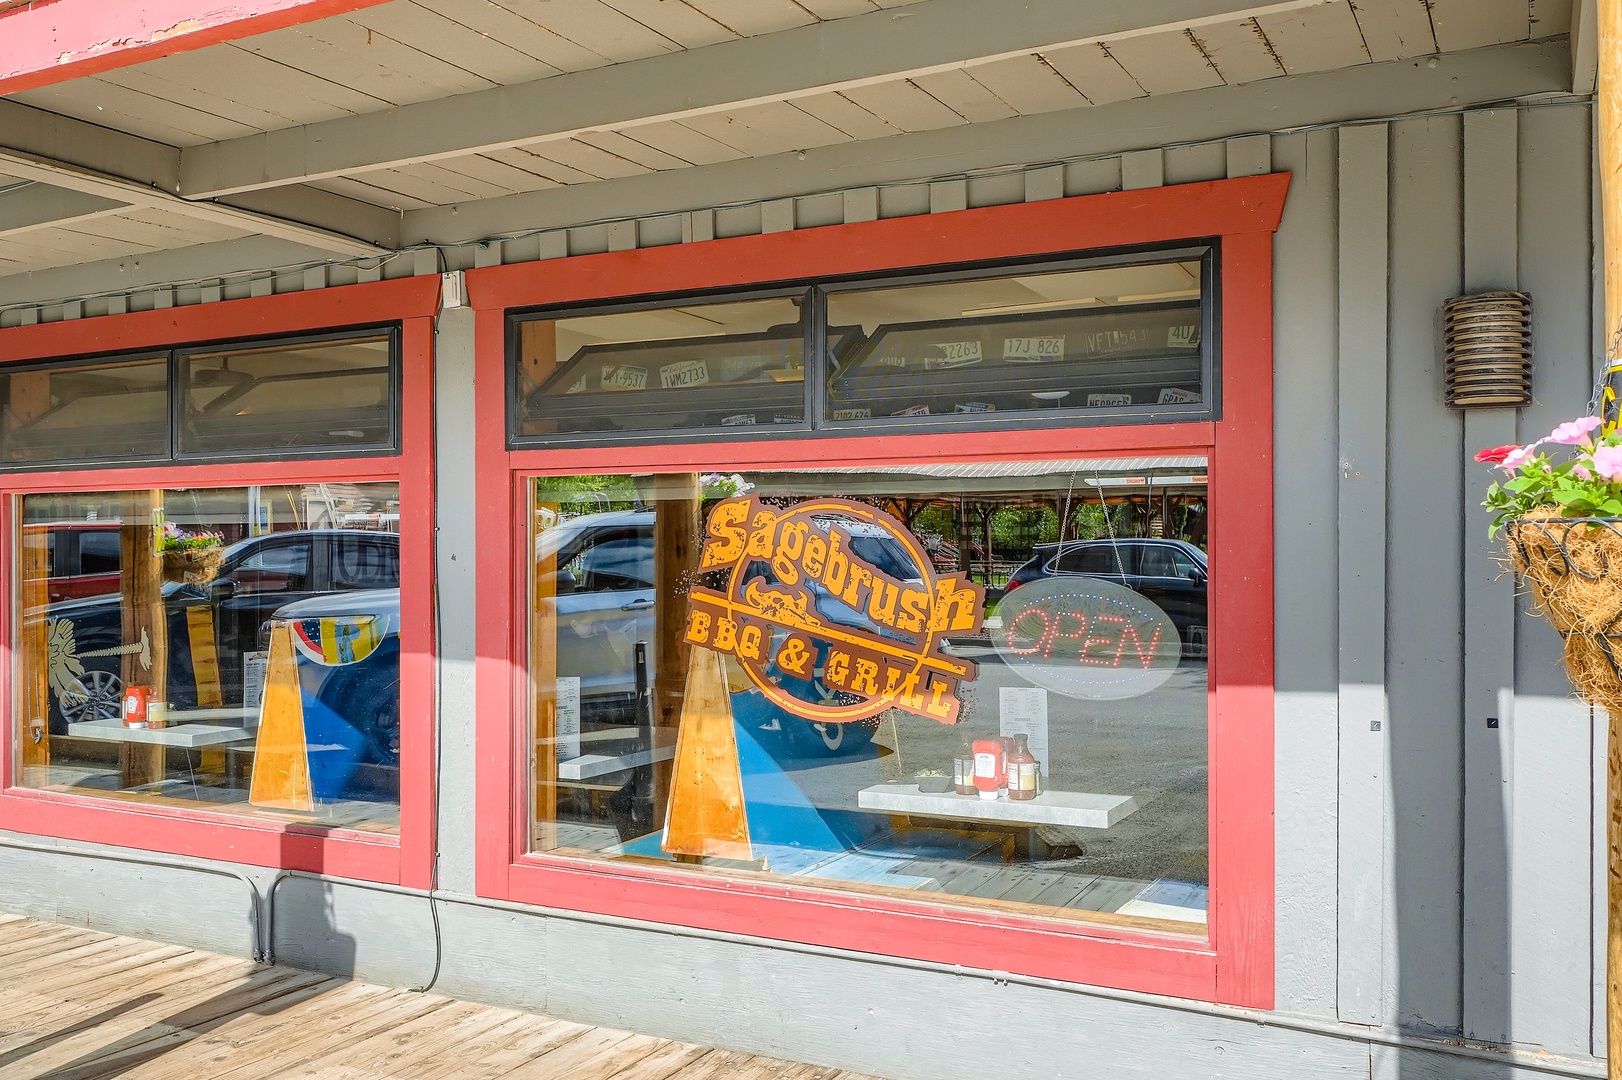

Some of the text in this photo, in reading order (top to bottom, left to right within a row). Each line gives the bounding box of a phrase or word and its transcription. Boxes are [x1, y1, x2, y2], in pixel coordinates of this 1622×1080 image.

[664, 367, 706, 388] 1WM2733
[1009, 339, 1060, 354] 17J 826
[701, 494, 977, 634] Sagebrush
[686, 609, 955, 719] BBQ & GRILL
[1008, 608, 1163, 670] OPEN
